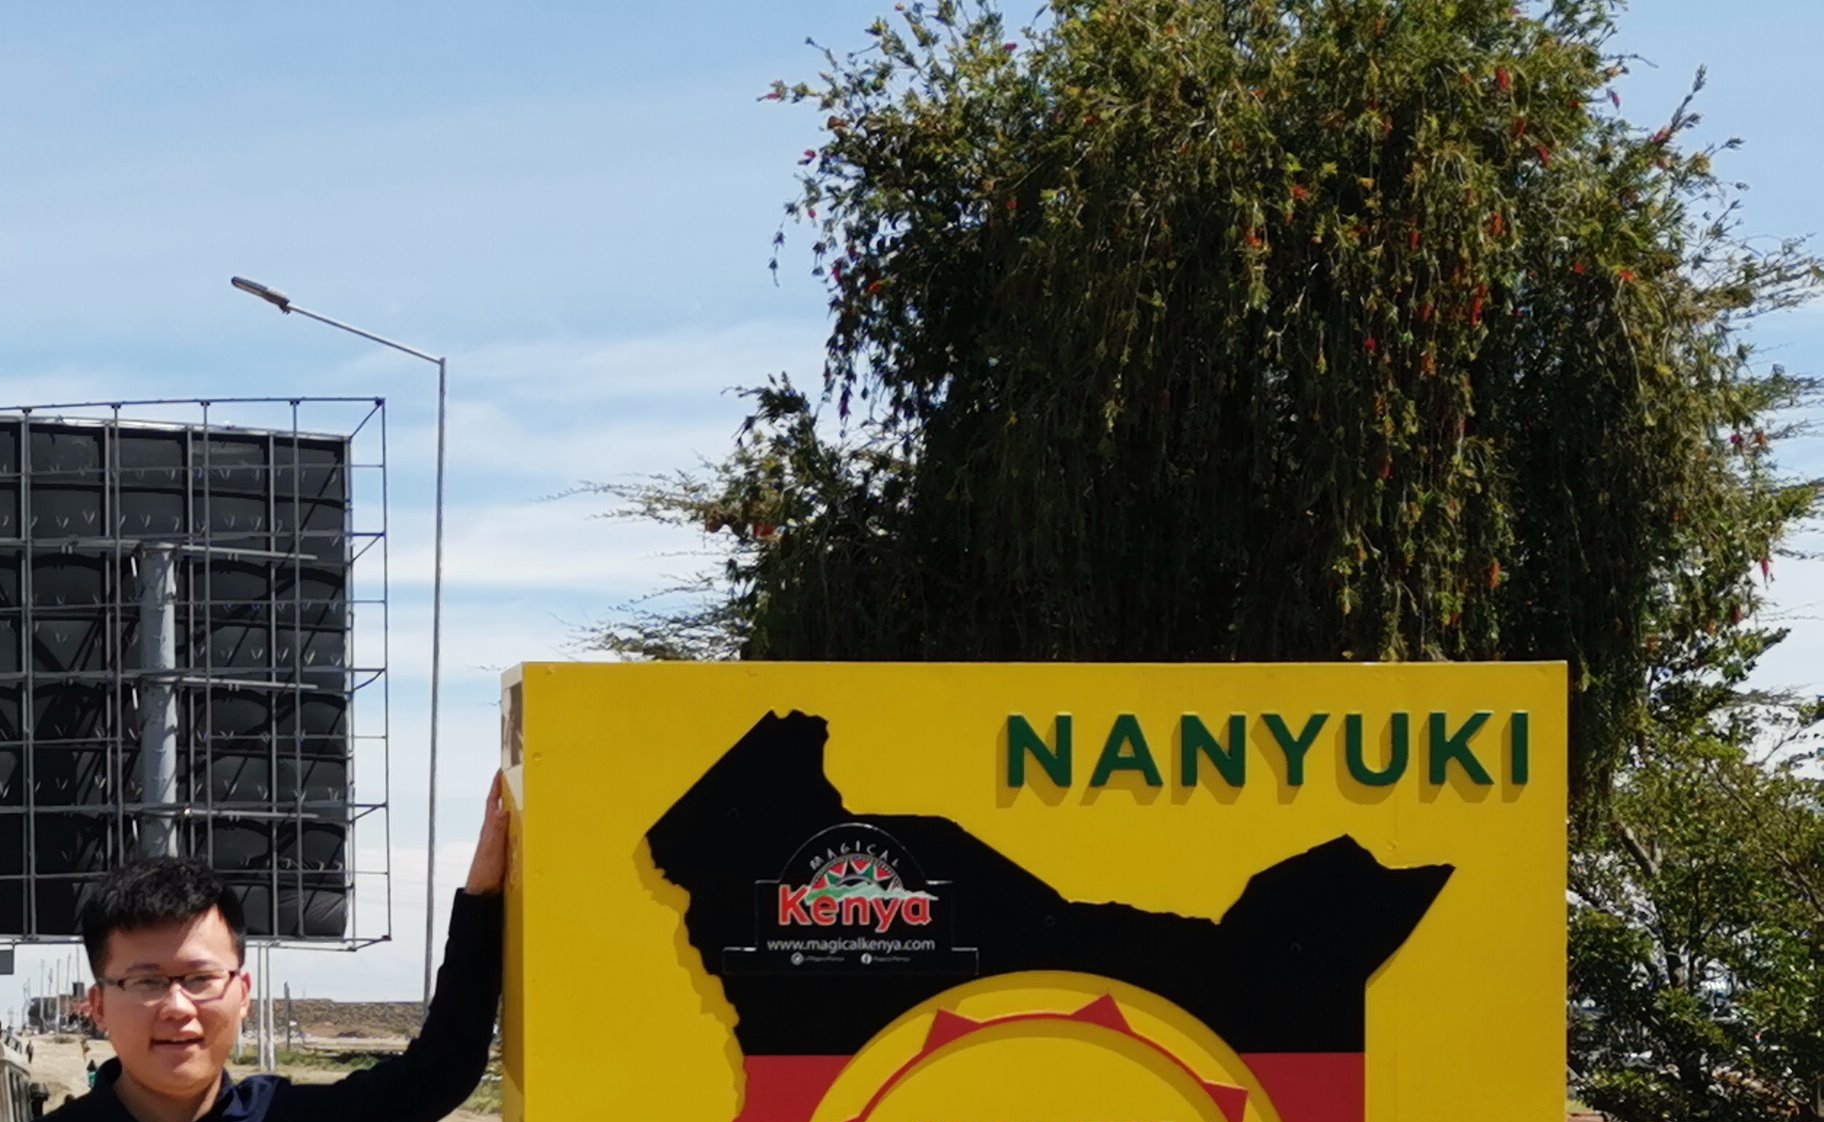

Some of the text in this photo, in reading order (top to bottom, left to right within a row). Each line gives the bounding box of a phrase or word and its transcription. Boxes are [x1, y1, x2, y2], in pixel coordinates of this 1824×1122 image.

[1006, 710, 1530, 788] NANYUKI
[809, 840, 900, 871] MAGICAL
[778, 884, 932, 933] Kenya
[767, 938, 935, 953] www.magicalkenya.com
